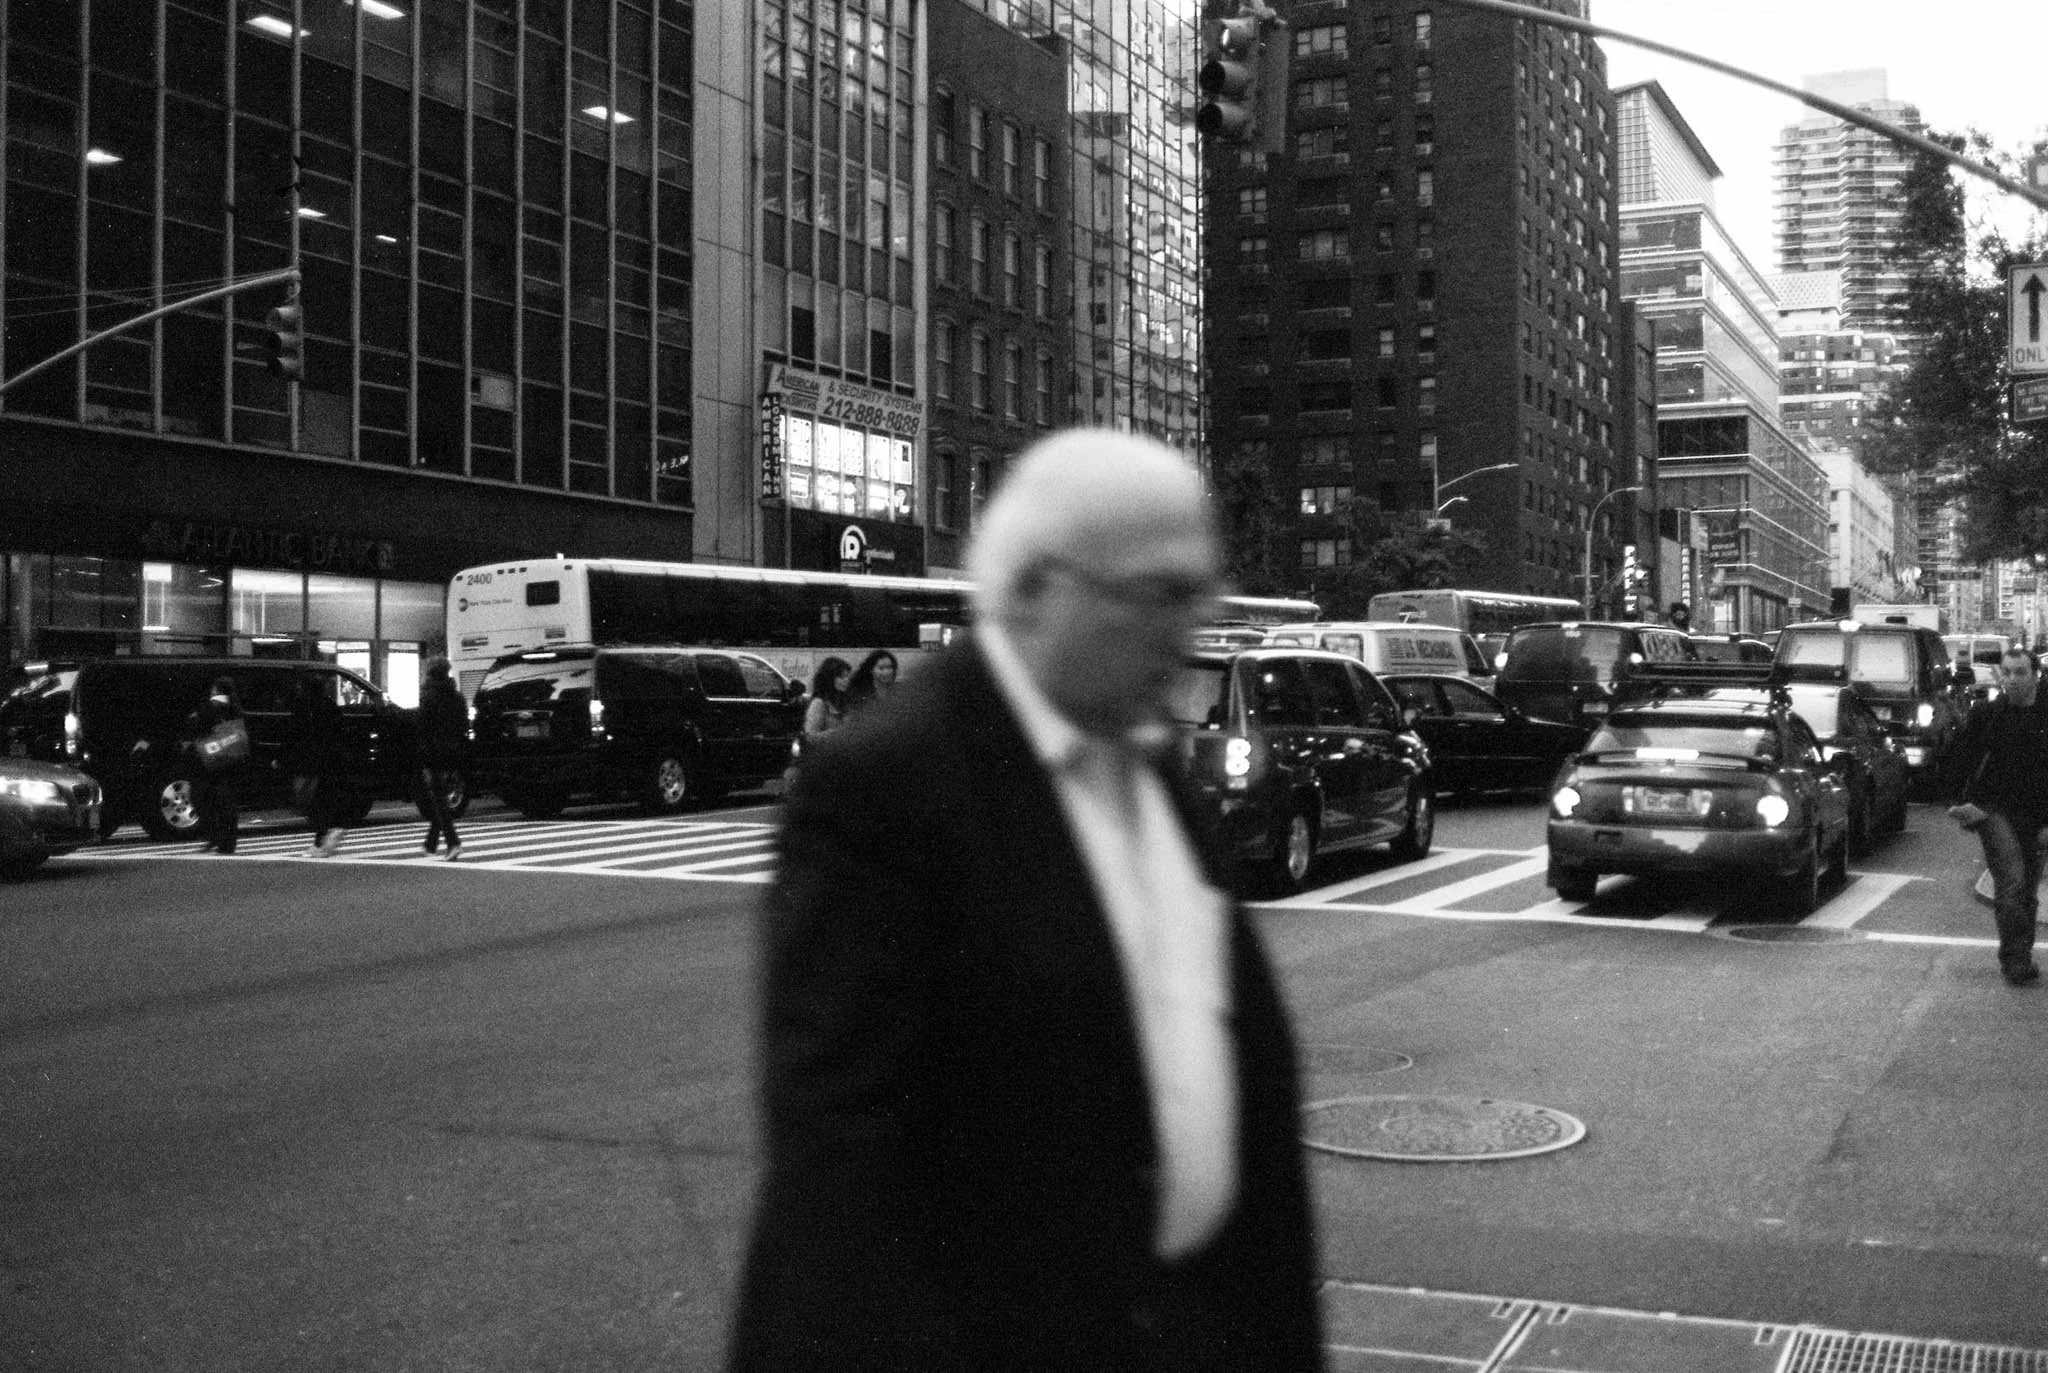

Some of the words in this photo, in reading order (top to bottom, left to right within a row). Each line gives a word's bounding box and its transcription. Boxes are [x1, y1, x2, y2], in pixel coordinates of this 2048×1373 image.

[2015, 347, 2048, 364] ONL
[837, 382, 882, 404] SECURITY
[883, 394, 923, 415] SYSTEMS
[761, 396, 771, 496] AMERICAN
[772, 395, 781, 495] LOCKSMITHS
[467, 574, 492, 586] 2400
